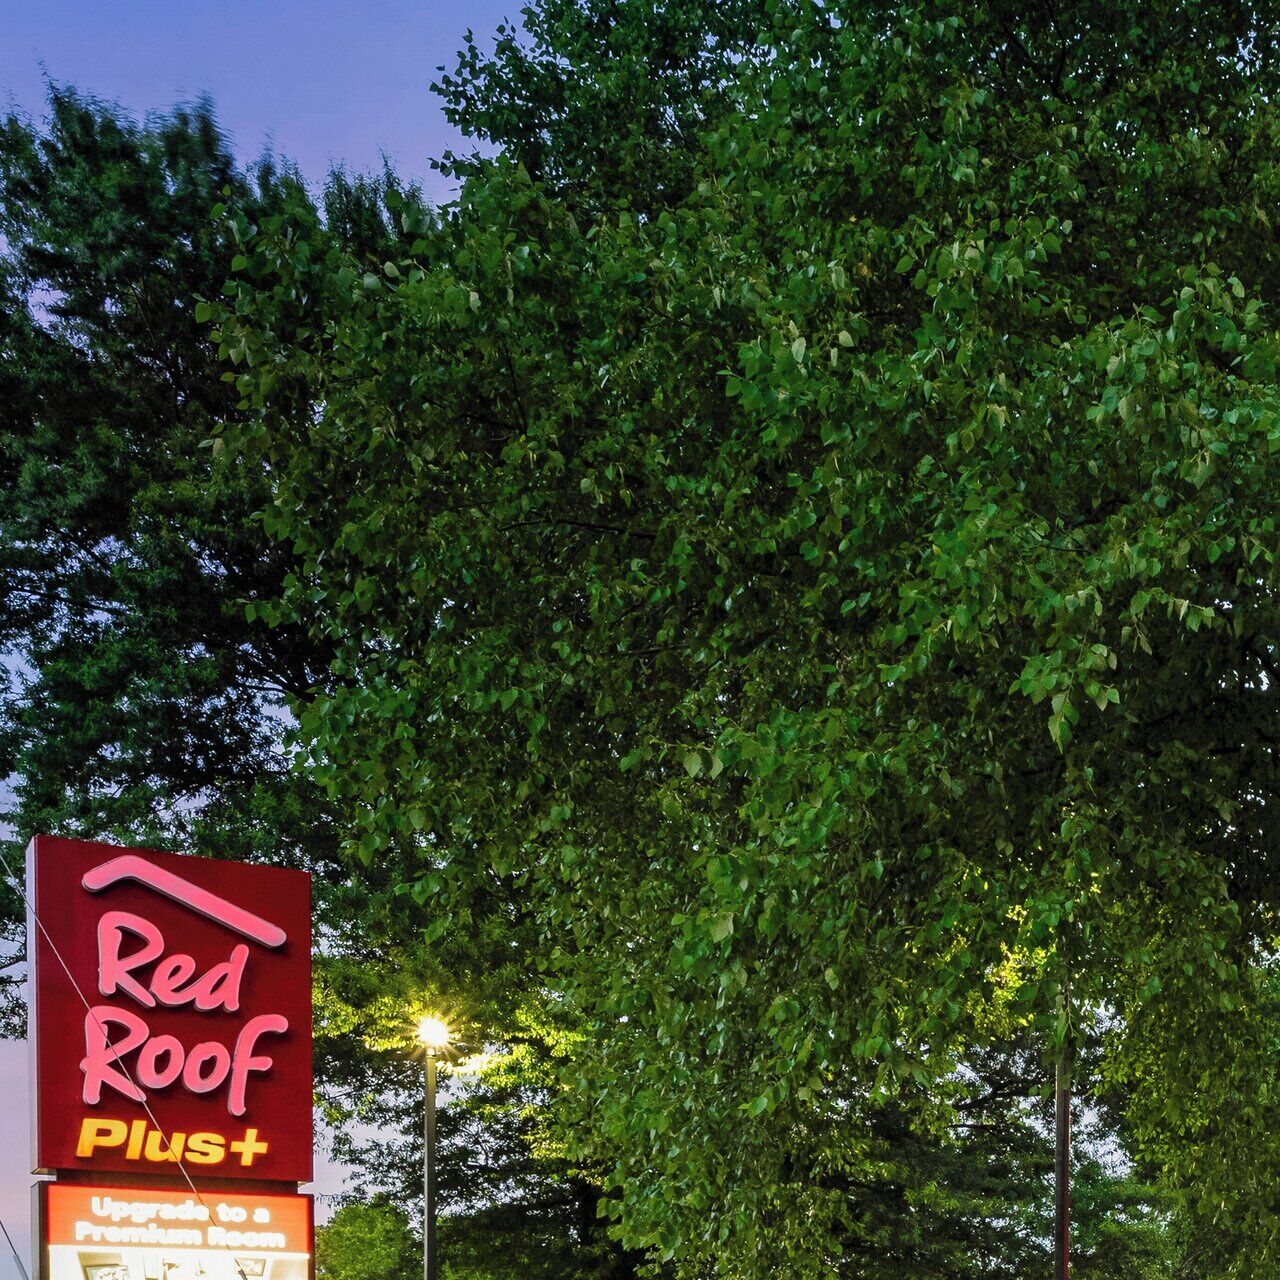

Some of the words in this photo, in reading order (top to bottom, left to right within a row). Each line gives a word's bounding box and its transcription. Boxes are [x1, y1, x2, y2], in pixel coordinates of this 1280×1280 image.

[97, 910, 249, 1013] Red
[80, 1005, 289, 1116] Roof
[76, 1118, 268, 1166] Plus+
[91, 1196, 210, 1223] Upgrade
[216, 1202, 247, 1222] to
[253, 1206, 270, 1223] a
[75, 1221, 202, 1246] Premium
[208, 1226, 286, 1248] Room
